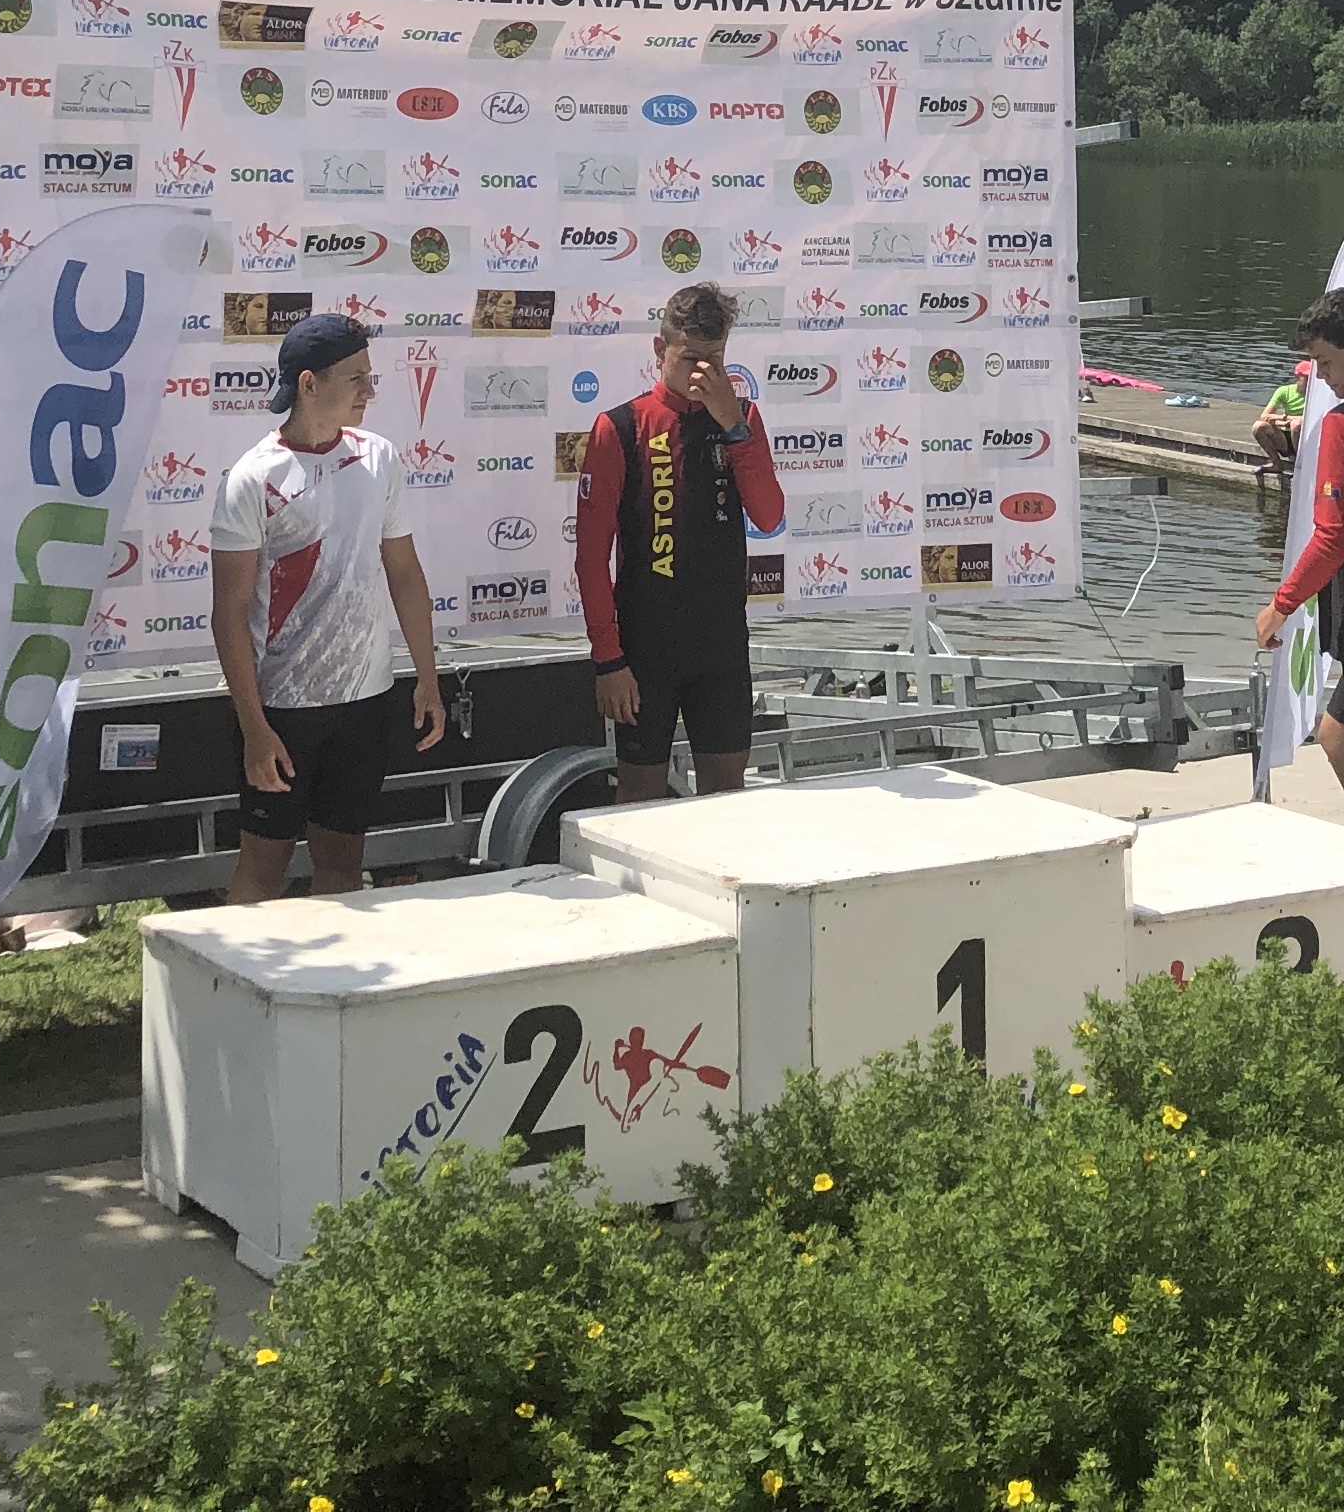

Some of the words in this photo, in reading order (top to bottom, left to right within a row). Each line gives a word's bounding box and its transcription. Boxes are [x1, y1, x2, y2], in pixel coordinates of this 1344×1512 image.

[146, 12, 208, 29] sonac
[266, 19, 303, 29] ALIOR
[401, 28, 462, 43] sonac
[644, 35, 698, 48] sonac
[708, 30, 762, 44] Fobos
[163, 40, 195, 62] PZK
[856, 39, 909, 52] sonac
[870, 61, 897, 80] PZK
[337, 89, 389, 100] MATERBUD
[579, 104, 629, 115] MATERBUD
[652, 102, 689, 118] KBS
[919, 96, 967, 113] Fobos
[231, 168, 294, 183] sonac
[480, 173, 538, 188] sonac
[712, 173, 765, 188] sonac
[922, 175, 971, 188] sonac
[43, 182, 88, 193] STACJA
[91, 182, 132, 193] SZTUM
[982, 192, 1016, 201] STACJA
[1018, 192, 1049, 201] SZTUM
[304, 233, 366, 253] Fobos
[560, 227, 618, 245] Fobos
[987, 259, 1020, 268] STACJA
[1023, 258, 1053, 268] SZTUM
[919, 292, 969, 309] Fobos
[516, 307, 550, 318] ALIOR
[859, 302, 908, 317] sonac
[404, 311, 463, 327] sonac
[407, 339, 437, 361] PZK
[767, 363, 819, 381] Fobos
[574, 382, 598, 392] LIDO
[212, 400, 254, 411] STACJA
[921, 437, 973, 453] sonac
[982, 429, 1033, 446] Fobos
[477, 455, 535, 472] sonac
[773, 460, 811, 471] STACJA
[813, 458, 844, 469] SZTUM
[648, 430, 675, 578] ASTORIA
[924, 516, 961, 528] STACJA
[963, 514, 994, 525] SZTUM
[860, 565, 913, 580] sonac
[961, 560, 990, 570] ALIOR
[751, 572, 782, 583] ALIOR
[470, 611, 511, 623] STACJA
[513, 606, 548, 619] SZTUM
[144, 614, 207, 633] sonac
[937, 938, 986, 1083] 1
[504, 1004, 586, 1168] 2
